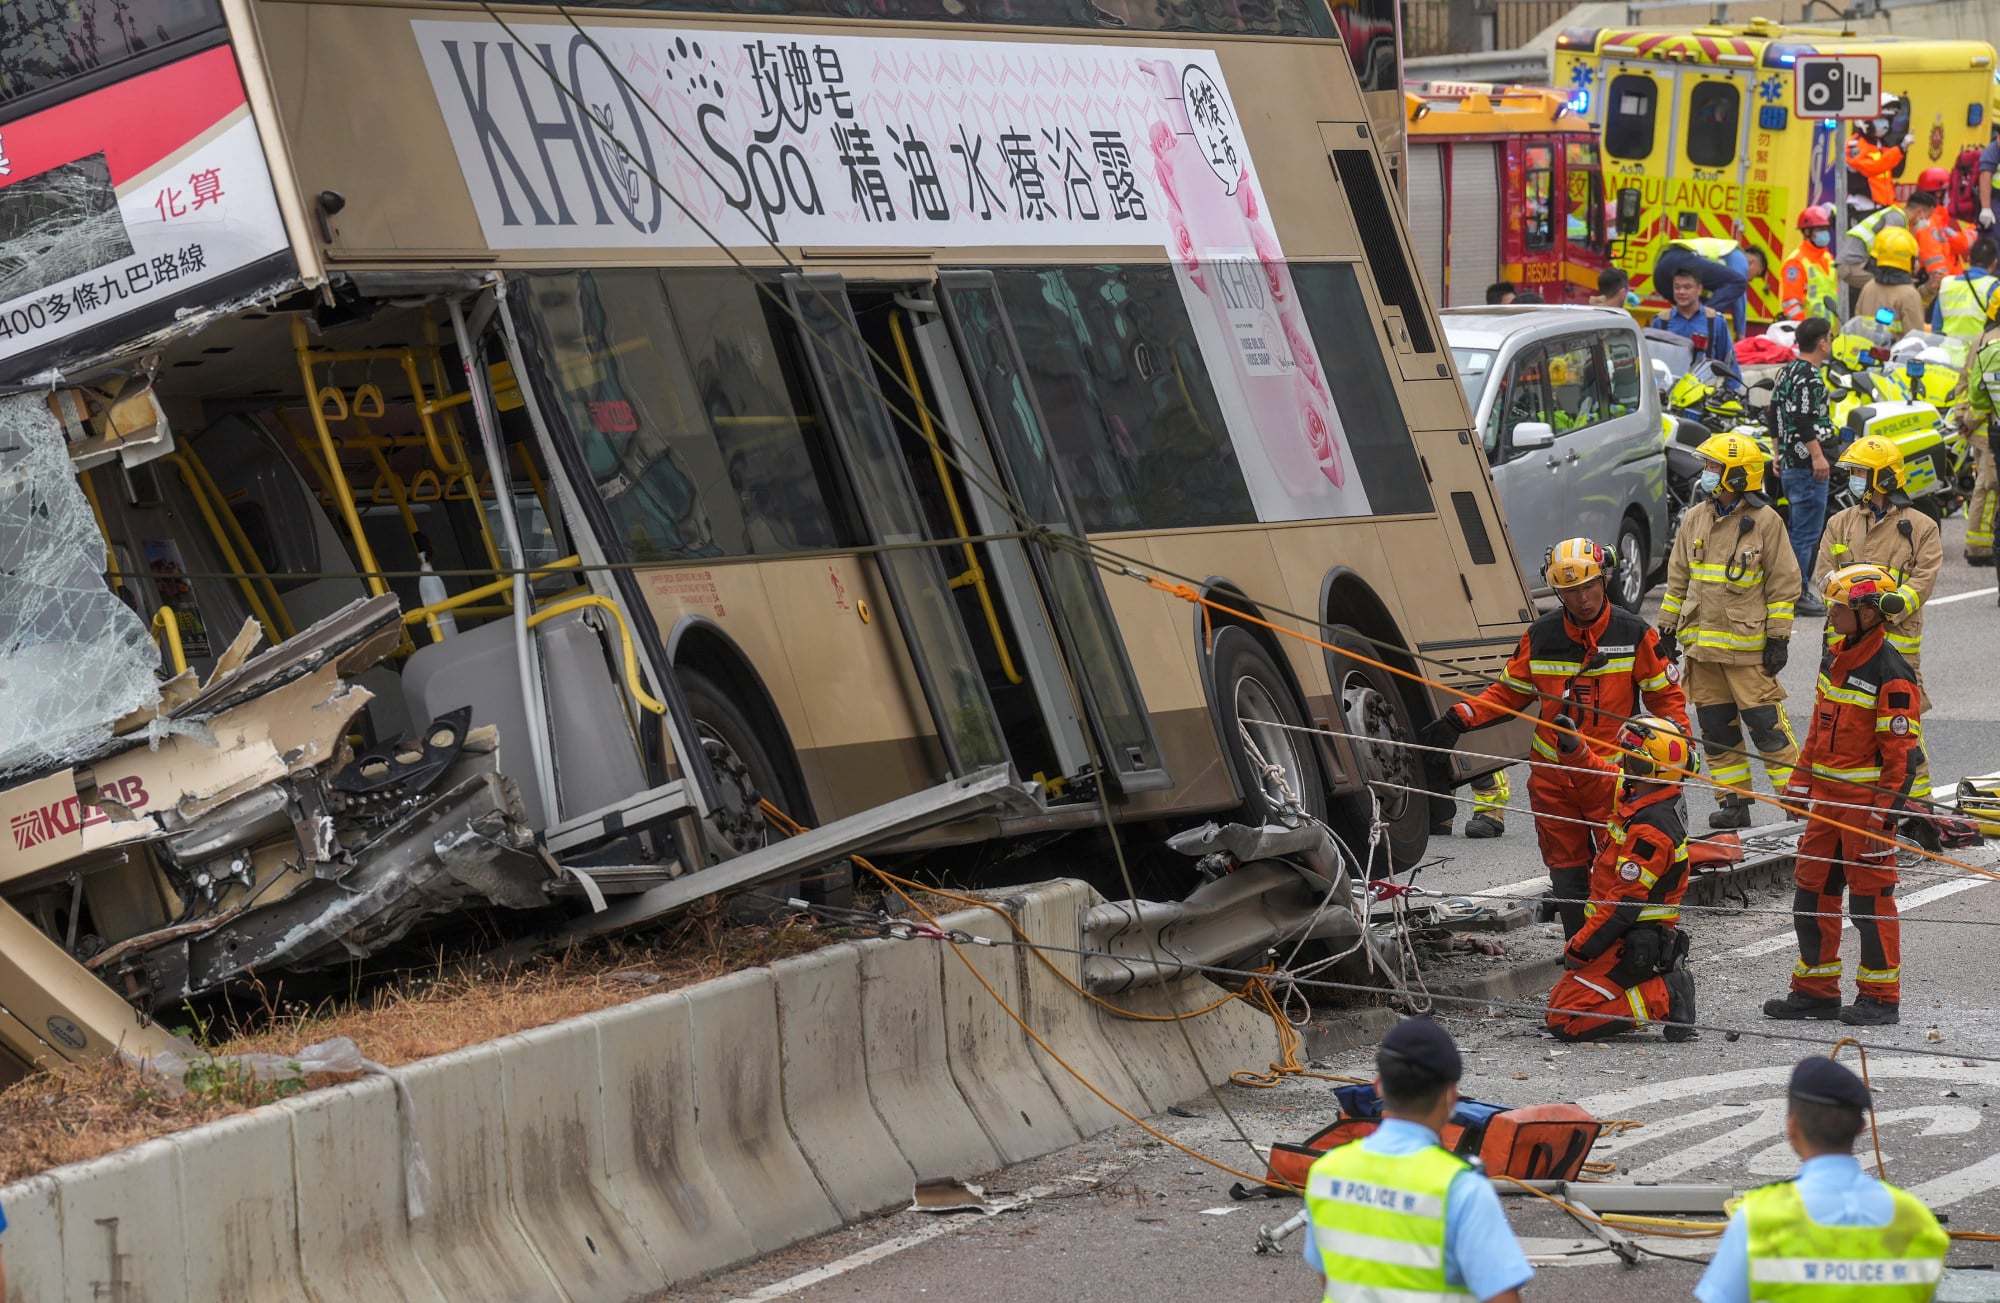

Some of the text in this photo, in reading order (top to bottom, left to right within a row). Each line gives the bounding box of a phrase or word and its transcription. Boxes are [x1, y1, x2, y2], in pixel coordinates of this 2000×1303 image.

[743, 39, 854, 143] 玫瑰皂
[1187, 79, 1226, 131] 新裝
[1435, 84, 1479, 95] FIRE
[441, 33, 661, 235] KHO
[1208, 127, 1239, 177] 上市
[154, 167, 226, 222] 化算
[697, 103, 825, 243] Spa
[830, 121, 1148, 223] 精油水療浴露
[1602, 175, 1740, 213] MBULANCE
[1746, 187, 1771, 215] 護
[1526, 262, 1557, 282] RESCUE
[1882, 416, 1912, 434] POLICE
[1346, 1182, 1397, 1209] POLICE
[1824, 1263, 1884, 1281] POLICE
